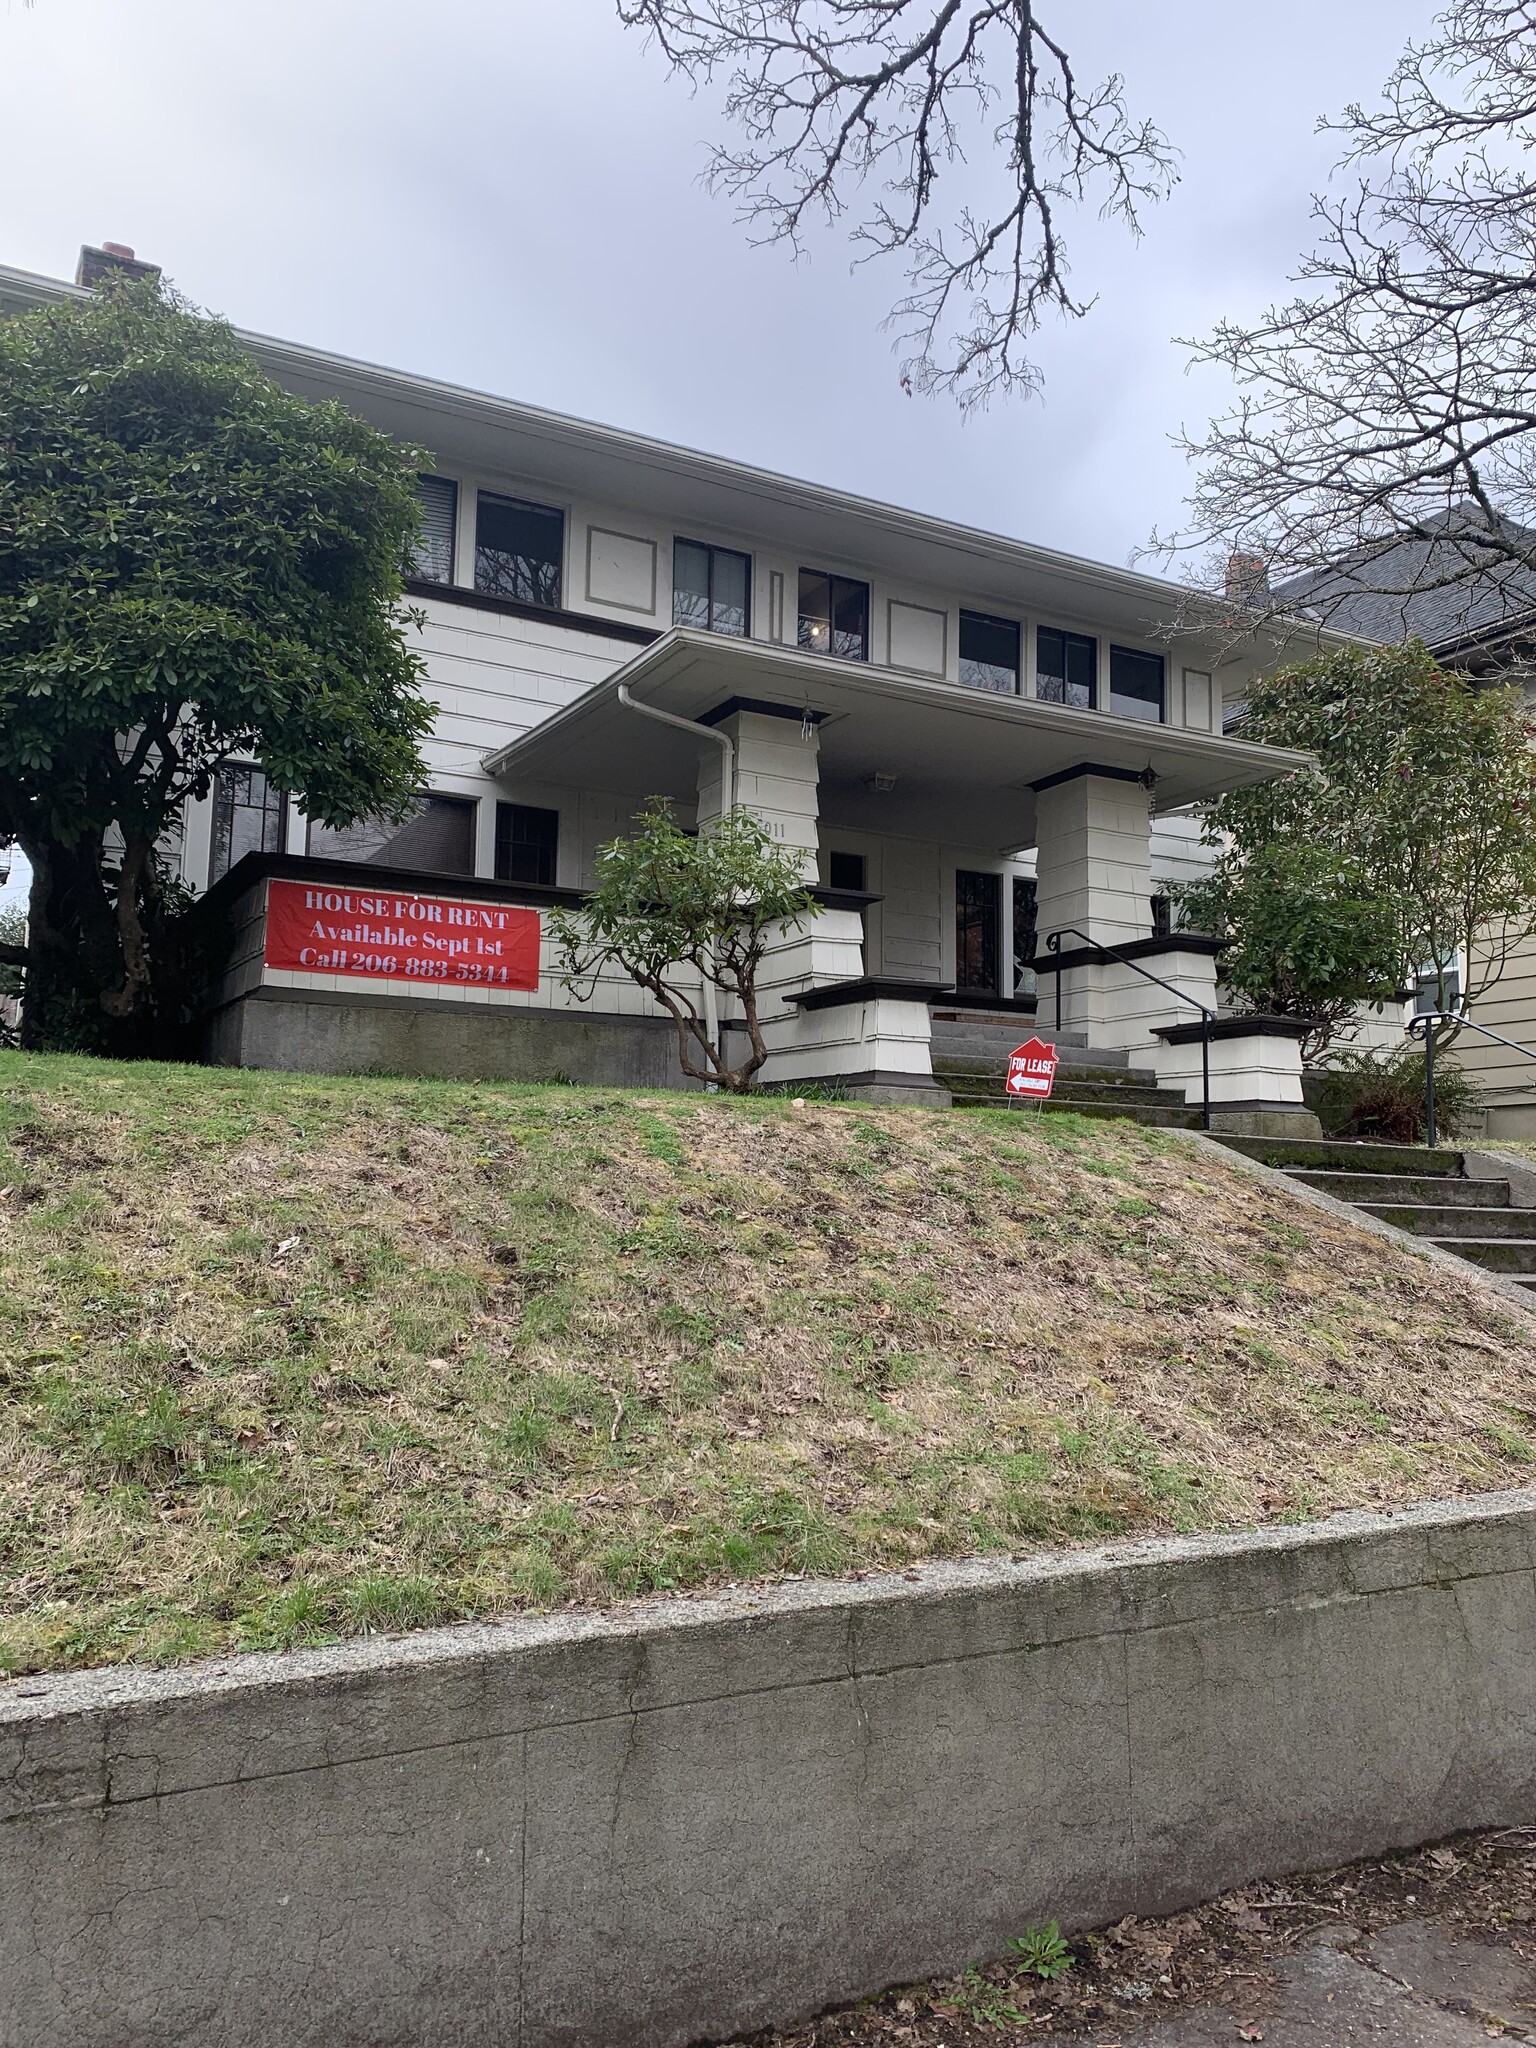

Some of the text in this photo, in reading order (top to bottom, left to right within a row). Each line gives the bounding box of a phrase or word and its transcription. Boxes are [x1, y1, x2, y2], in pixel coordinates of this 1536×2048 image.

[305, 890, 510, 930] HOUSE FOR RENT
[309, 920, 505, 957] Available Sept 1st
[299, 947, 510, 983] Call 206-883-5344
[1012, 1057, 1053, 1074] FOR LEASE
